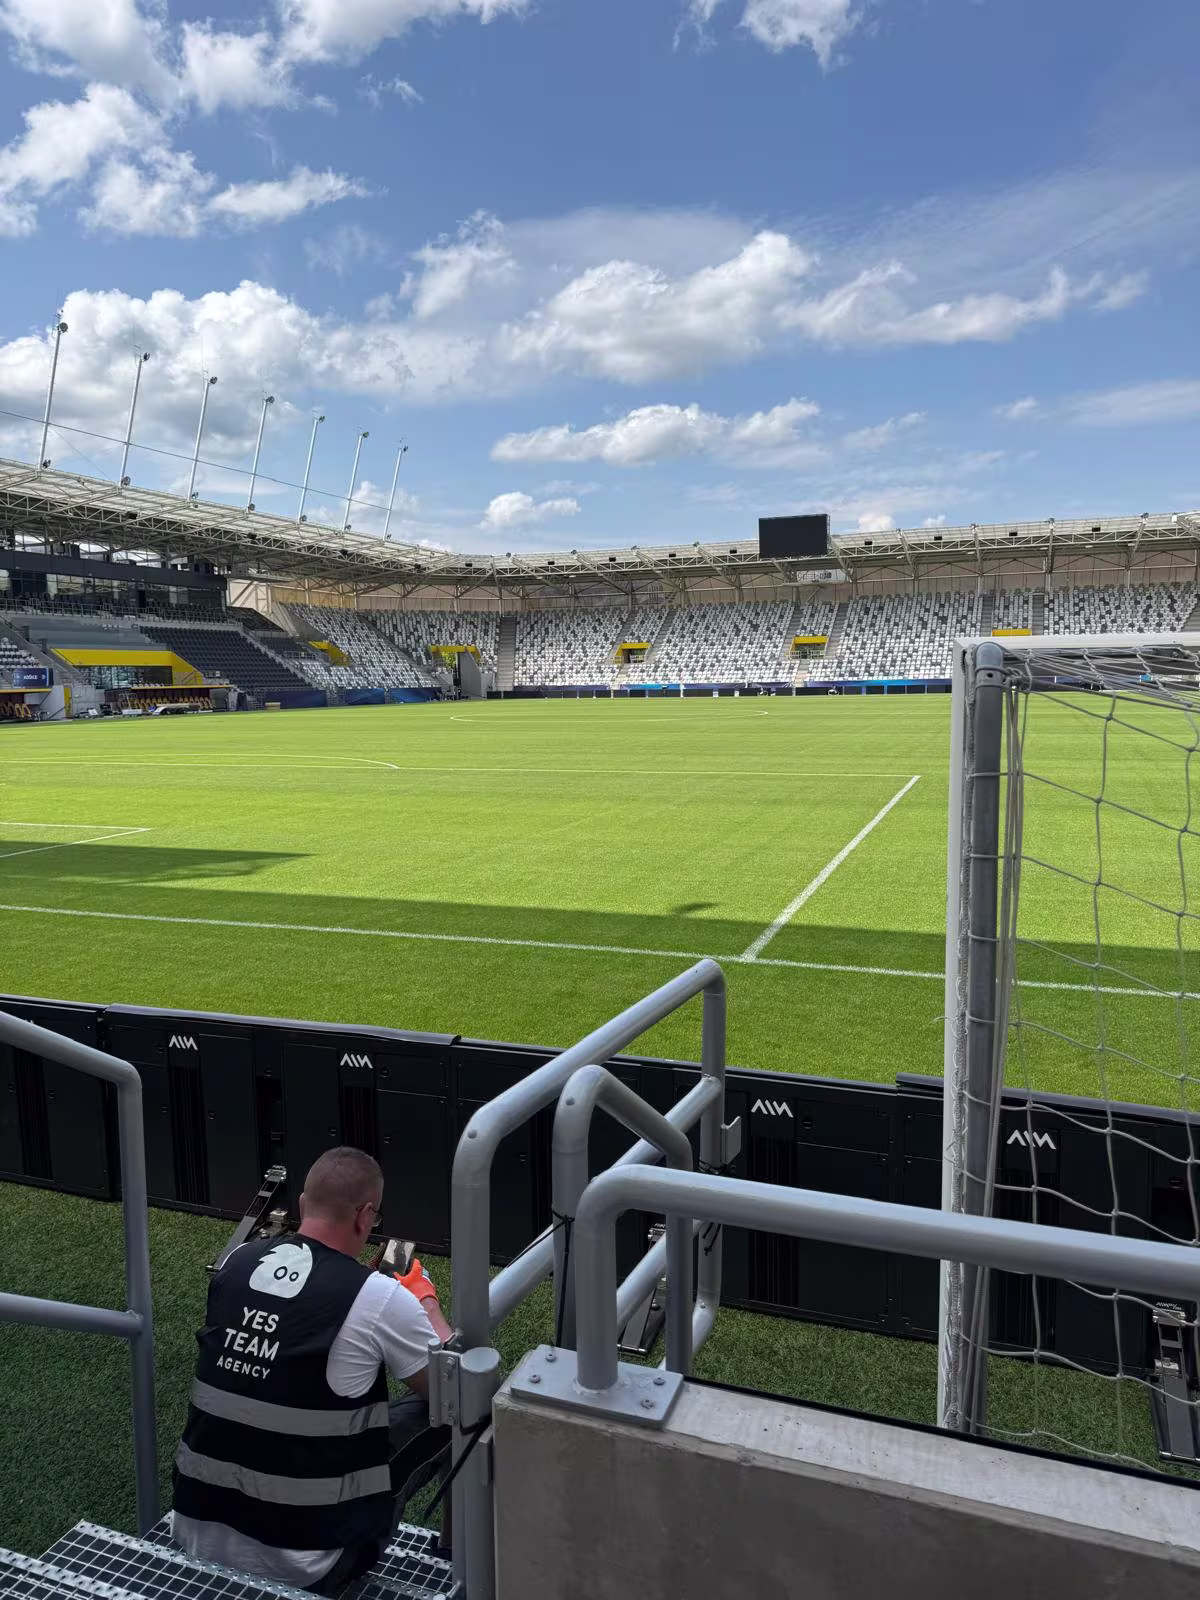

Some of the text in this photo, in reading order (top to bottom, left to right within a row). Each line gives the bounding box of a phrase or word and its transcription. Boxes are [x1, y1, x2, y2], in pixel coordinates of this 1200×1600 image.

[242, 1306, 279, 1333] YES
[224, 1327, 280, 1361] TEAM
[216, 1355, 271, 1379] AGENCY
